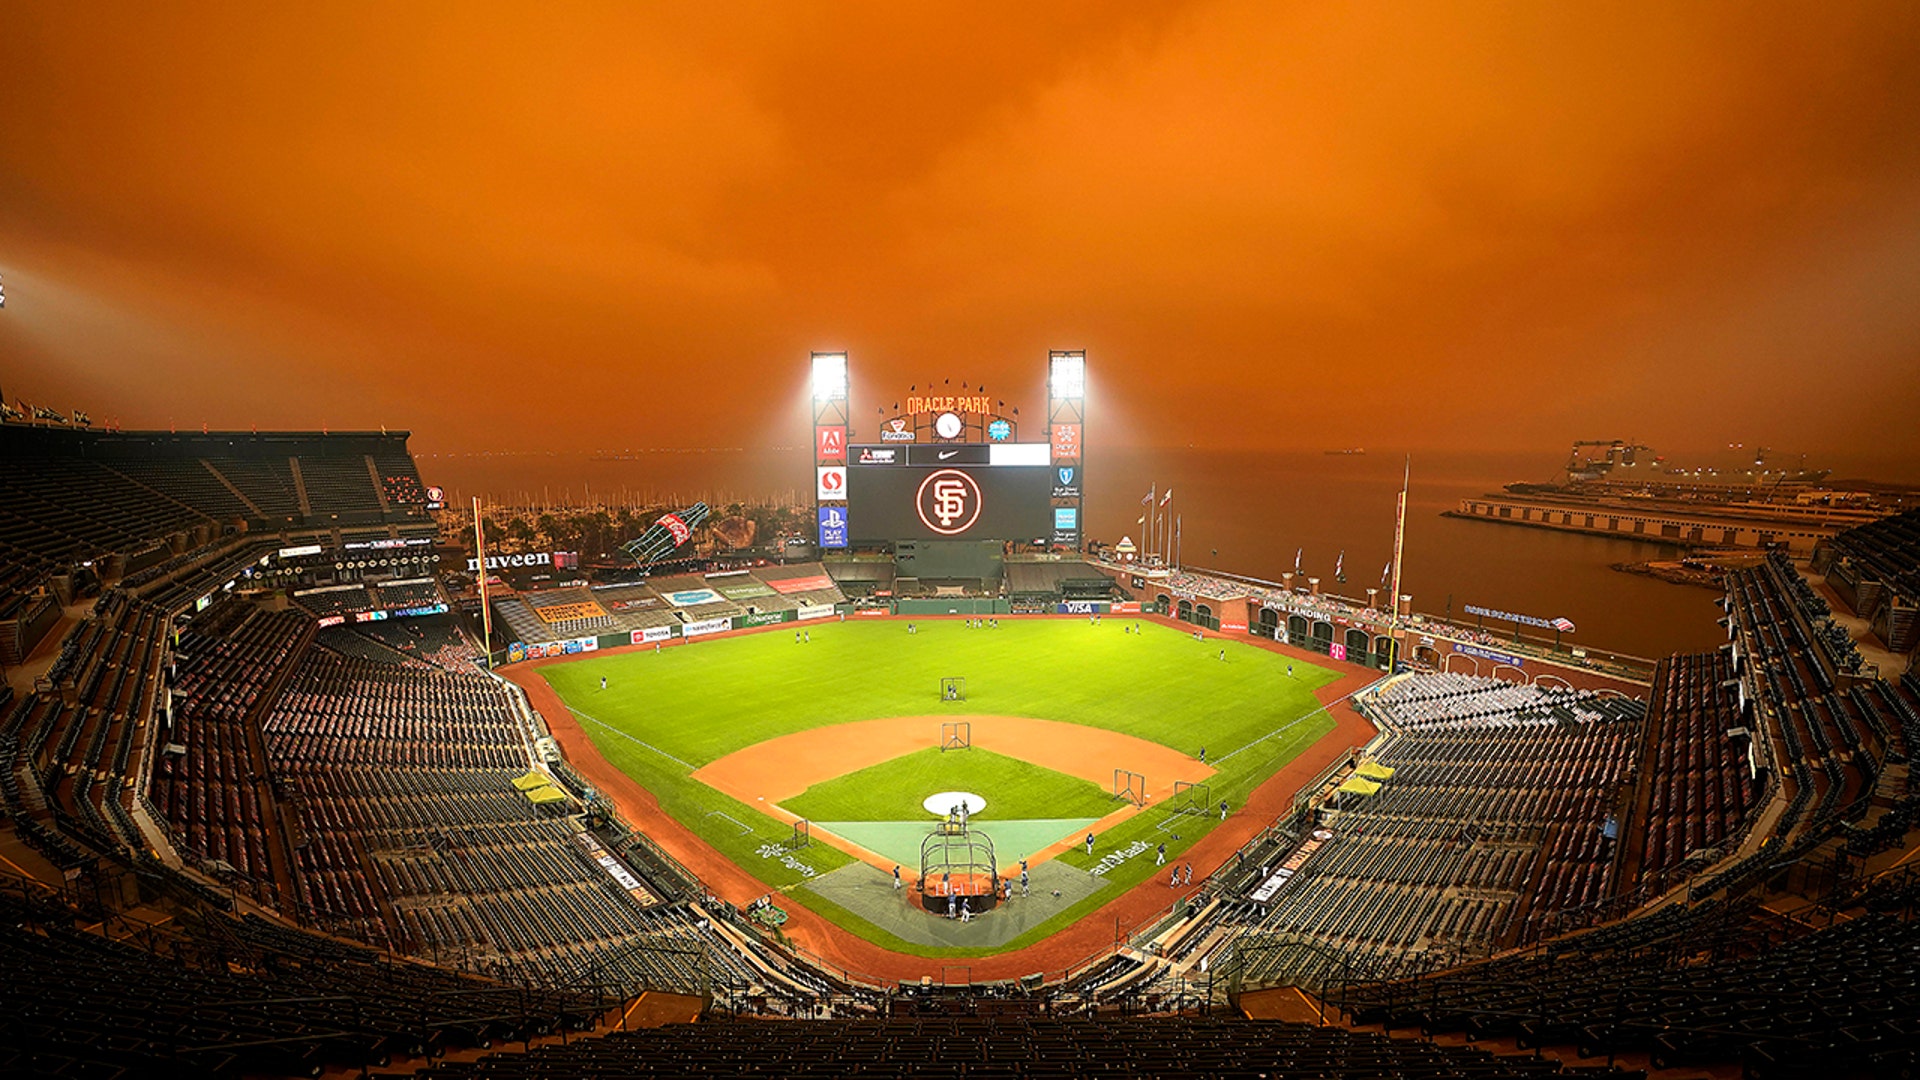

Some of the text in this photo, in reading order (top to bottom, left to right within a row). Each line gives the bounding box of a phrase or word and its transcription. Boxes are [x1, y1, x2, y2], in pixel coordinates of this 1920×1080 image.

[907, 397, 991, 415] ORACLE PARK
[467, 552, 551, 571] nuveen
[1067, 604, 1093, 614] VISA
[1288, 605, 1331, 622] LANDING
[645, 630, 669, 638] TOYOTA
